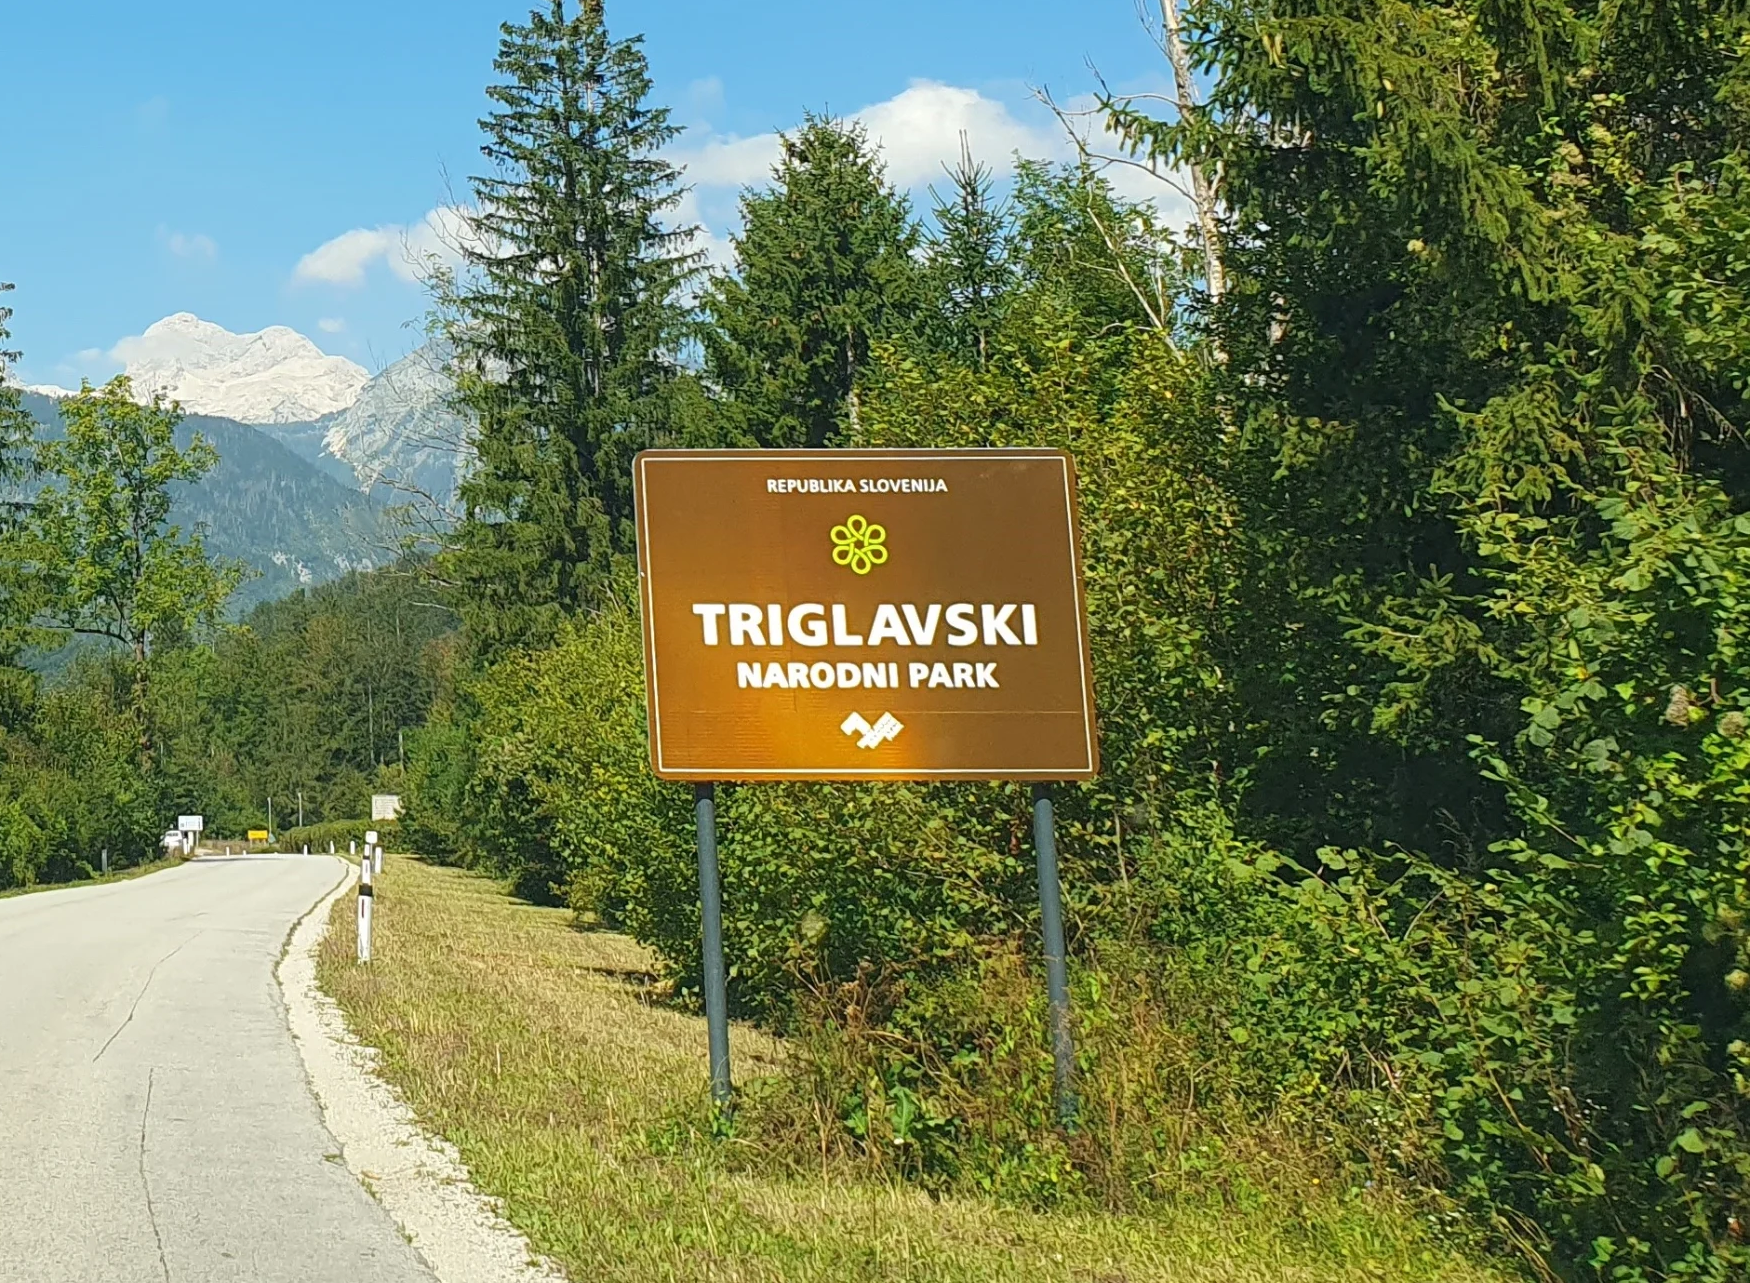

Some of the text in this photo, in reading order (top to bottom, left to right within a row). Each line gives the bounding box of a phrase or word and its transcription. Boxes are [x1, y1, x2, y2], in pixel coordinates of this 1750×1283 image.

[766, 478, 948, 493] REPUBLIKA SLOVENIJA
[692, 603, 1038, 647] TRIGLAVSKI
[737, 662, 1000, 689] NARODNI PARK
